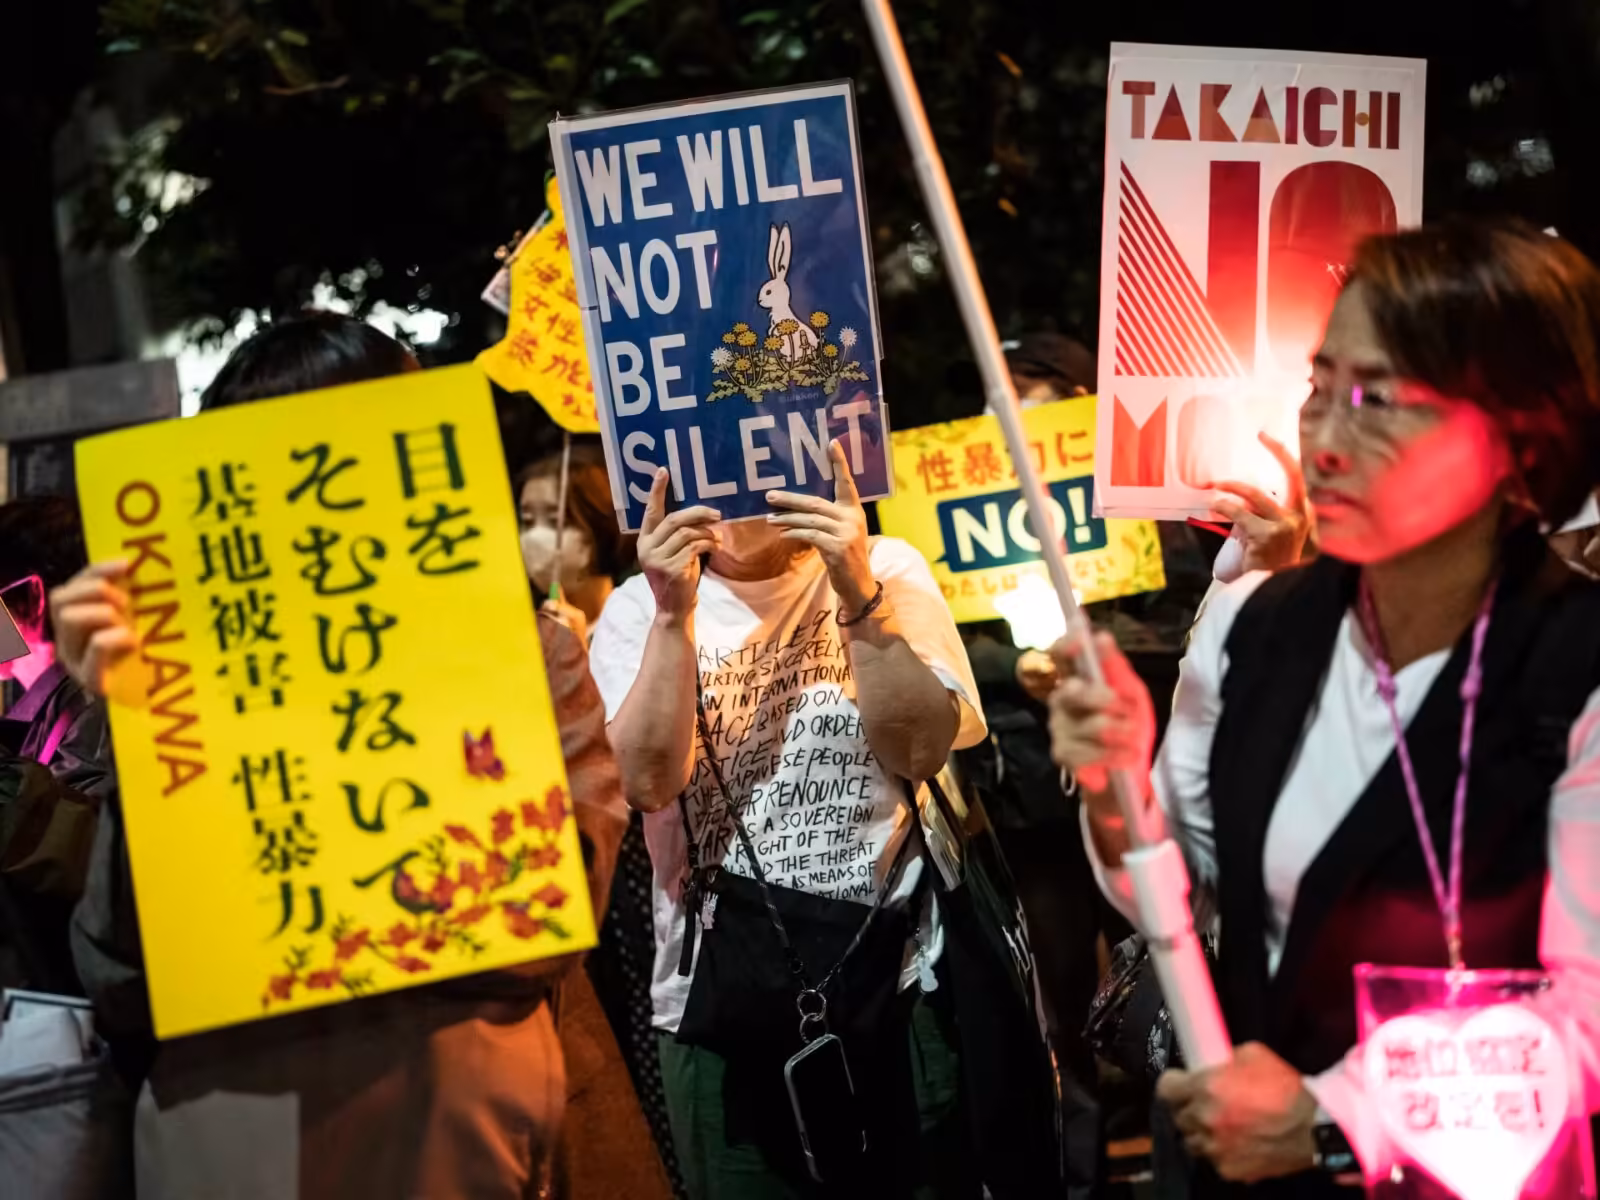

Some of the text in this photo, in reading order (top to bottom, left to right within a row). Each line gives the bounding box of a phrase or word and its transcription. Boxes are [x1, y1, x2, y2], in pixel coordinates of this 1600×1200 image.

[1122, 81, 1400, 149] TAKAICHI
[575, 119, 843, 227] WE WILL
[590, 230, 718, 322] NOT
[1114, 159, 1398, 378] NO
[605, 333, 697, 417] BE
[621, 400, 872, 503] SILENT
[916, 430, 1093, 495] 性暴力に
[1110, 393, 1245, 489] MO
[392, 421, 482, 575] 目を
[951, 486, 1092, 563] NO!
[116, 480, 207, 799] OKINAWA
[698, 622, 810, 668] ARTICLE
[701, 639, 846, 687] IRING SINCERELY
[185, 461, 324, 942] 基地被害 性暴力
[285, 442, 438, 914] そむけないで
[704, 664, 854, 711] AN INTERNATIONA
[757, 692, 808, 732] BASED
[813, 688, 844, 707] ON
[764, 775, 872, 813] RENOUNCE
[806, 747, 874, 778] PEOPLE
[735, 826, 858, 864] RGHT OF THE
[763, 817, 774, 834] A
[780, 804, 875, 831] SOVEREIGN
[775, 854, 811, 873] THE
[815, 842, 876, 866] THREAT
[791, 875, 805, 889] AS
[809, 868, 855, 886] MEANS
[858, 861, 877, 878] OF
